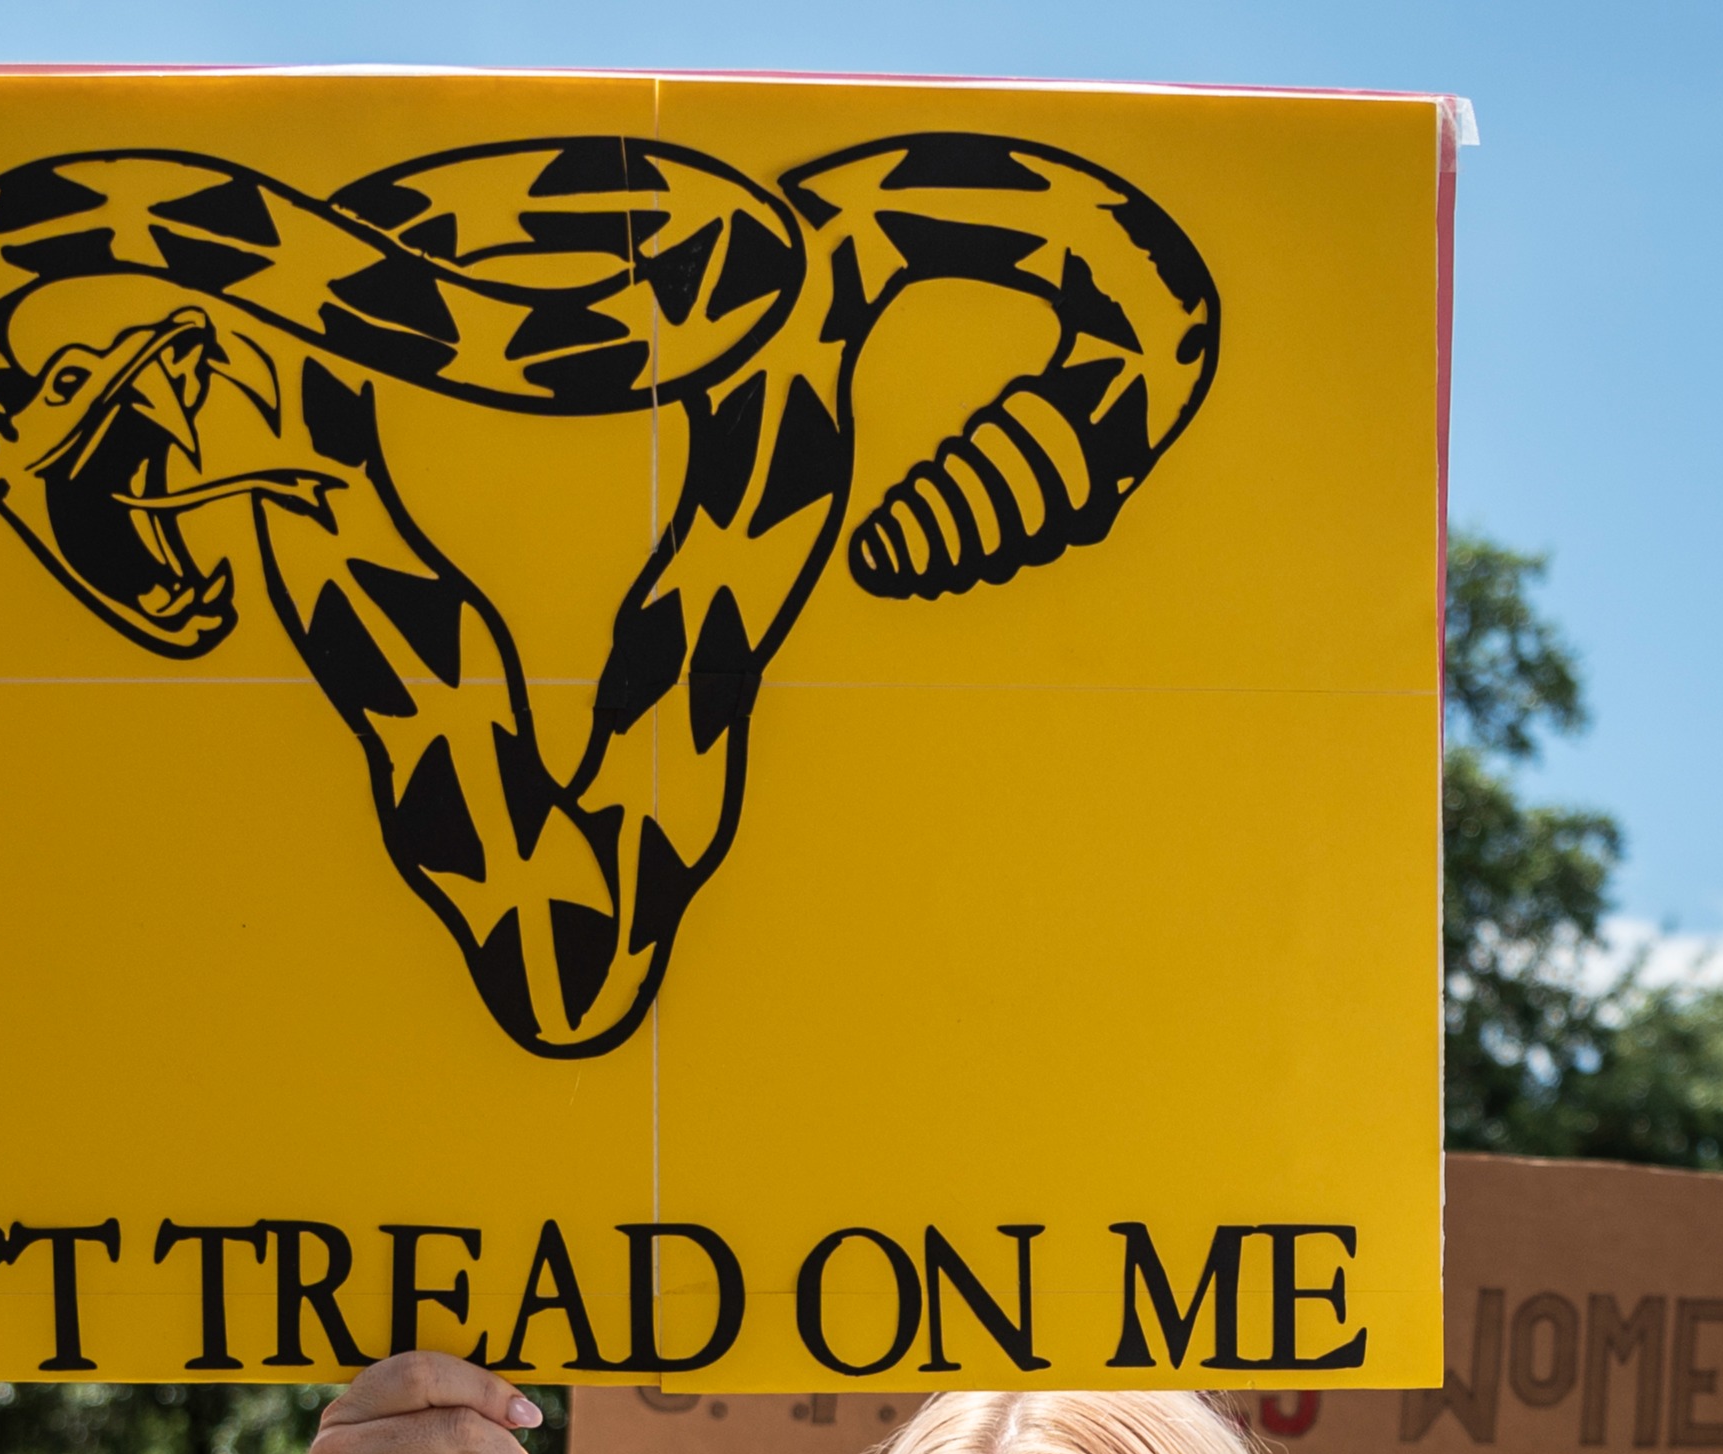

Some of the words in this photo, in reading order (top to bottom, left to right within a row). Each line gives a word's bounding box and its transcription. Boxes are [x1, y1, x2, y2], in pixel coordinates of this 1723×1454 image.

[154, 1218, 746, 1369] TREAD
[795, 1224, 1052, 1377] ON
[1106, 1220, 1368, 1371] ME
